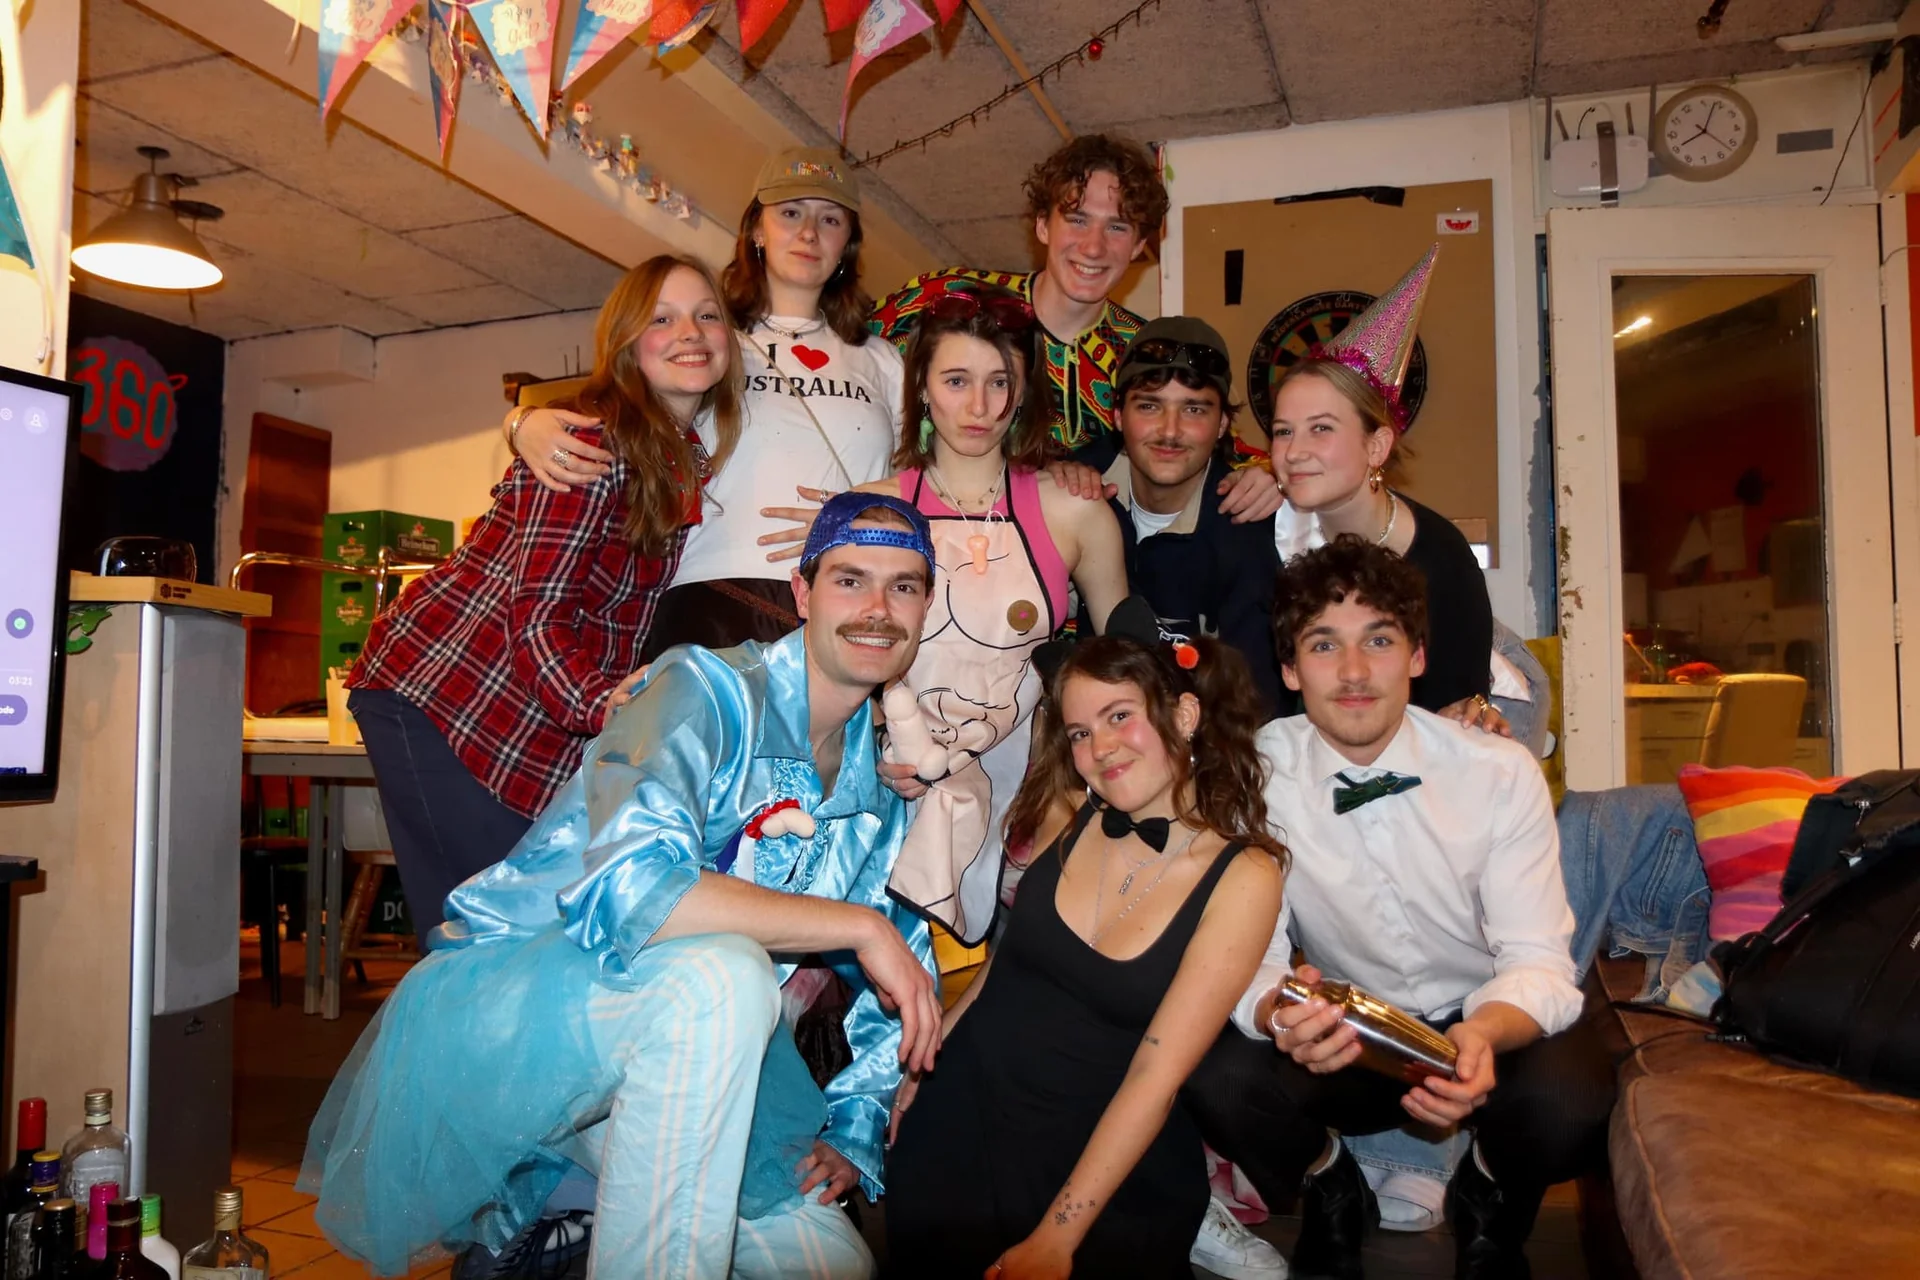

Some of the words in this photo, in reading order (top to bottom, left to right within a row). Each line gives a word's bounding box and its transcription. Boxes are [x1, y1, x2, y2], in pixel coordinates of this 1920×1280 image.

[1681, 104, 1692, 114] 12
[1728, 110, 1736, 118] 3
[1671, 116, 1681, 125] 11
[1733, 124, 1741, 132] 4
[1667, 131, 1678, 140] 10
[1729, 138, 1737, 147] 5
[1672, 145, 1680, 154] 9
[1700, 155, 1707, 164] 7
[1717, 151, 1725, 160] 6
[766, 343, 778, 370] I
